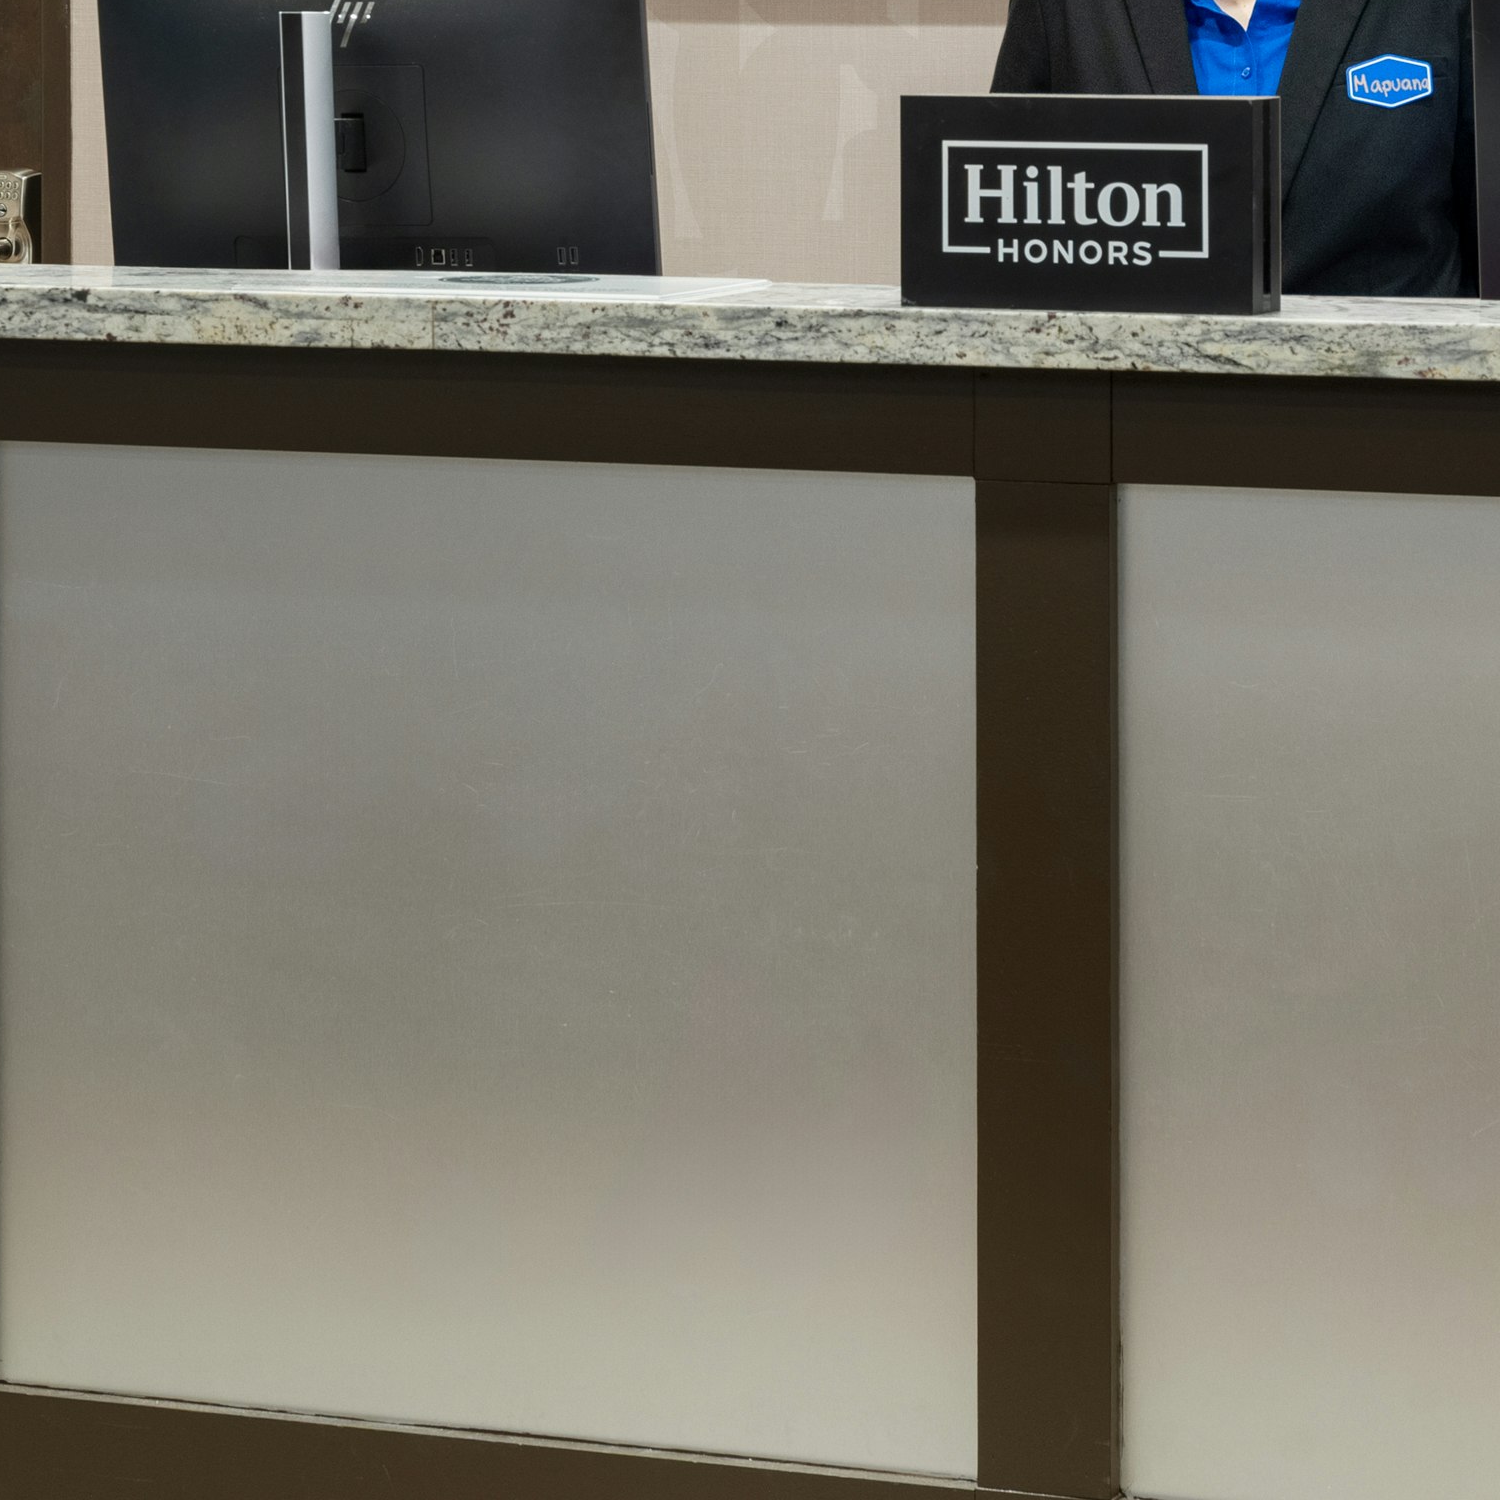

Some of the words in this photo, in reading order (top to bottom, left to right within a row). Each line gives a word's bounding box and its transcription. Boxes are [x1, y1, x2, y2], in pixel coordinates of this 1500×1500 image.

[1353, 73, 1430, 98] Mapuana
[963, 164, 1186, 227] Hilton
[998, 238, 1153, 266] HONORS
